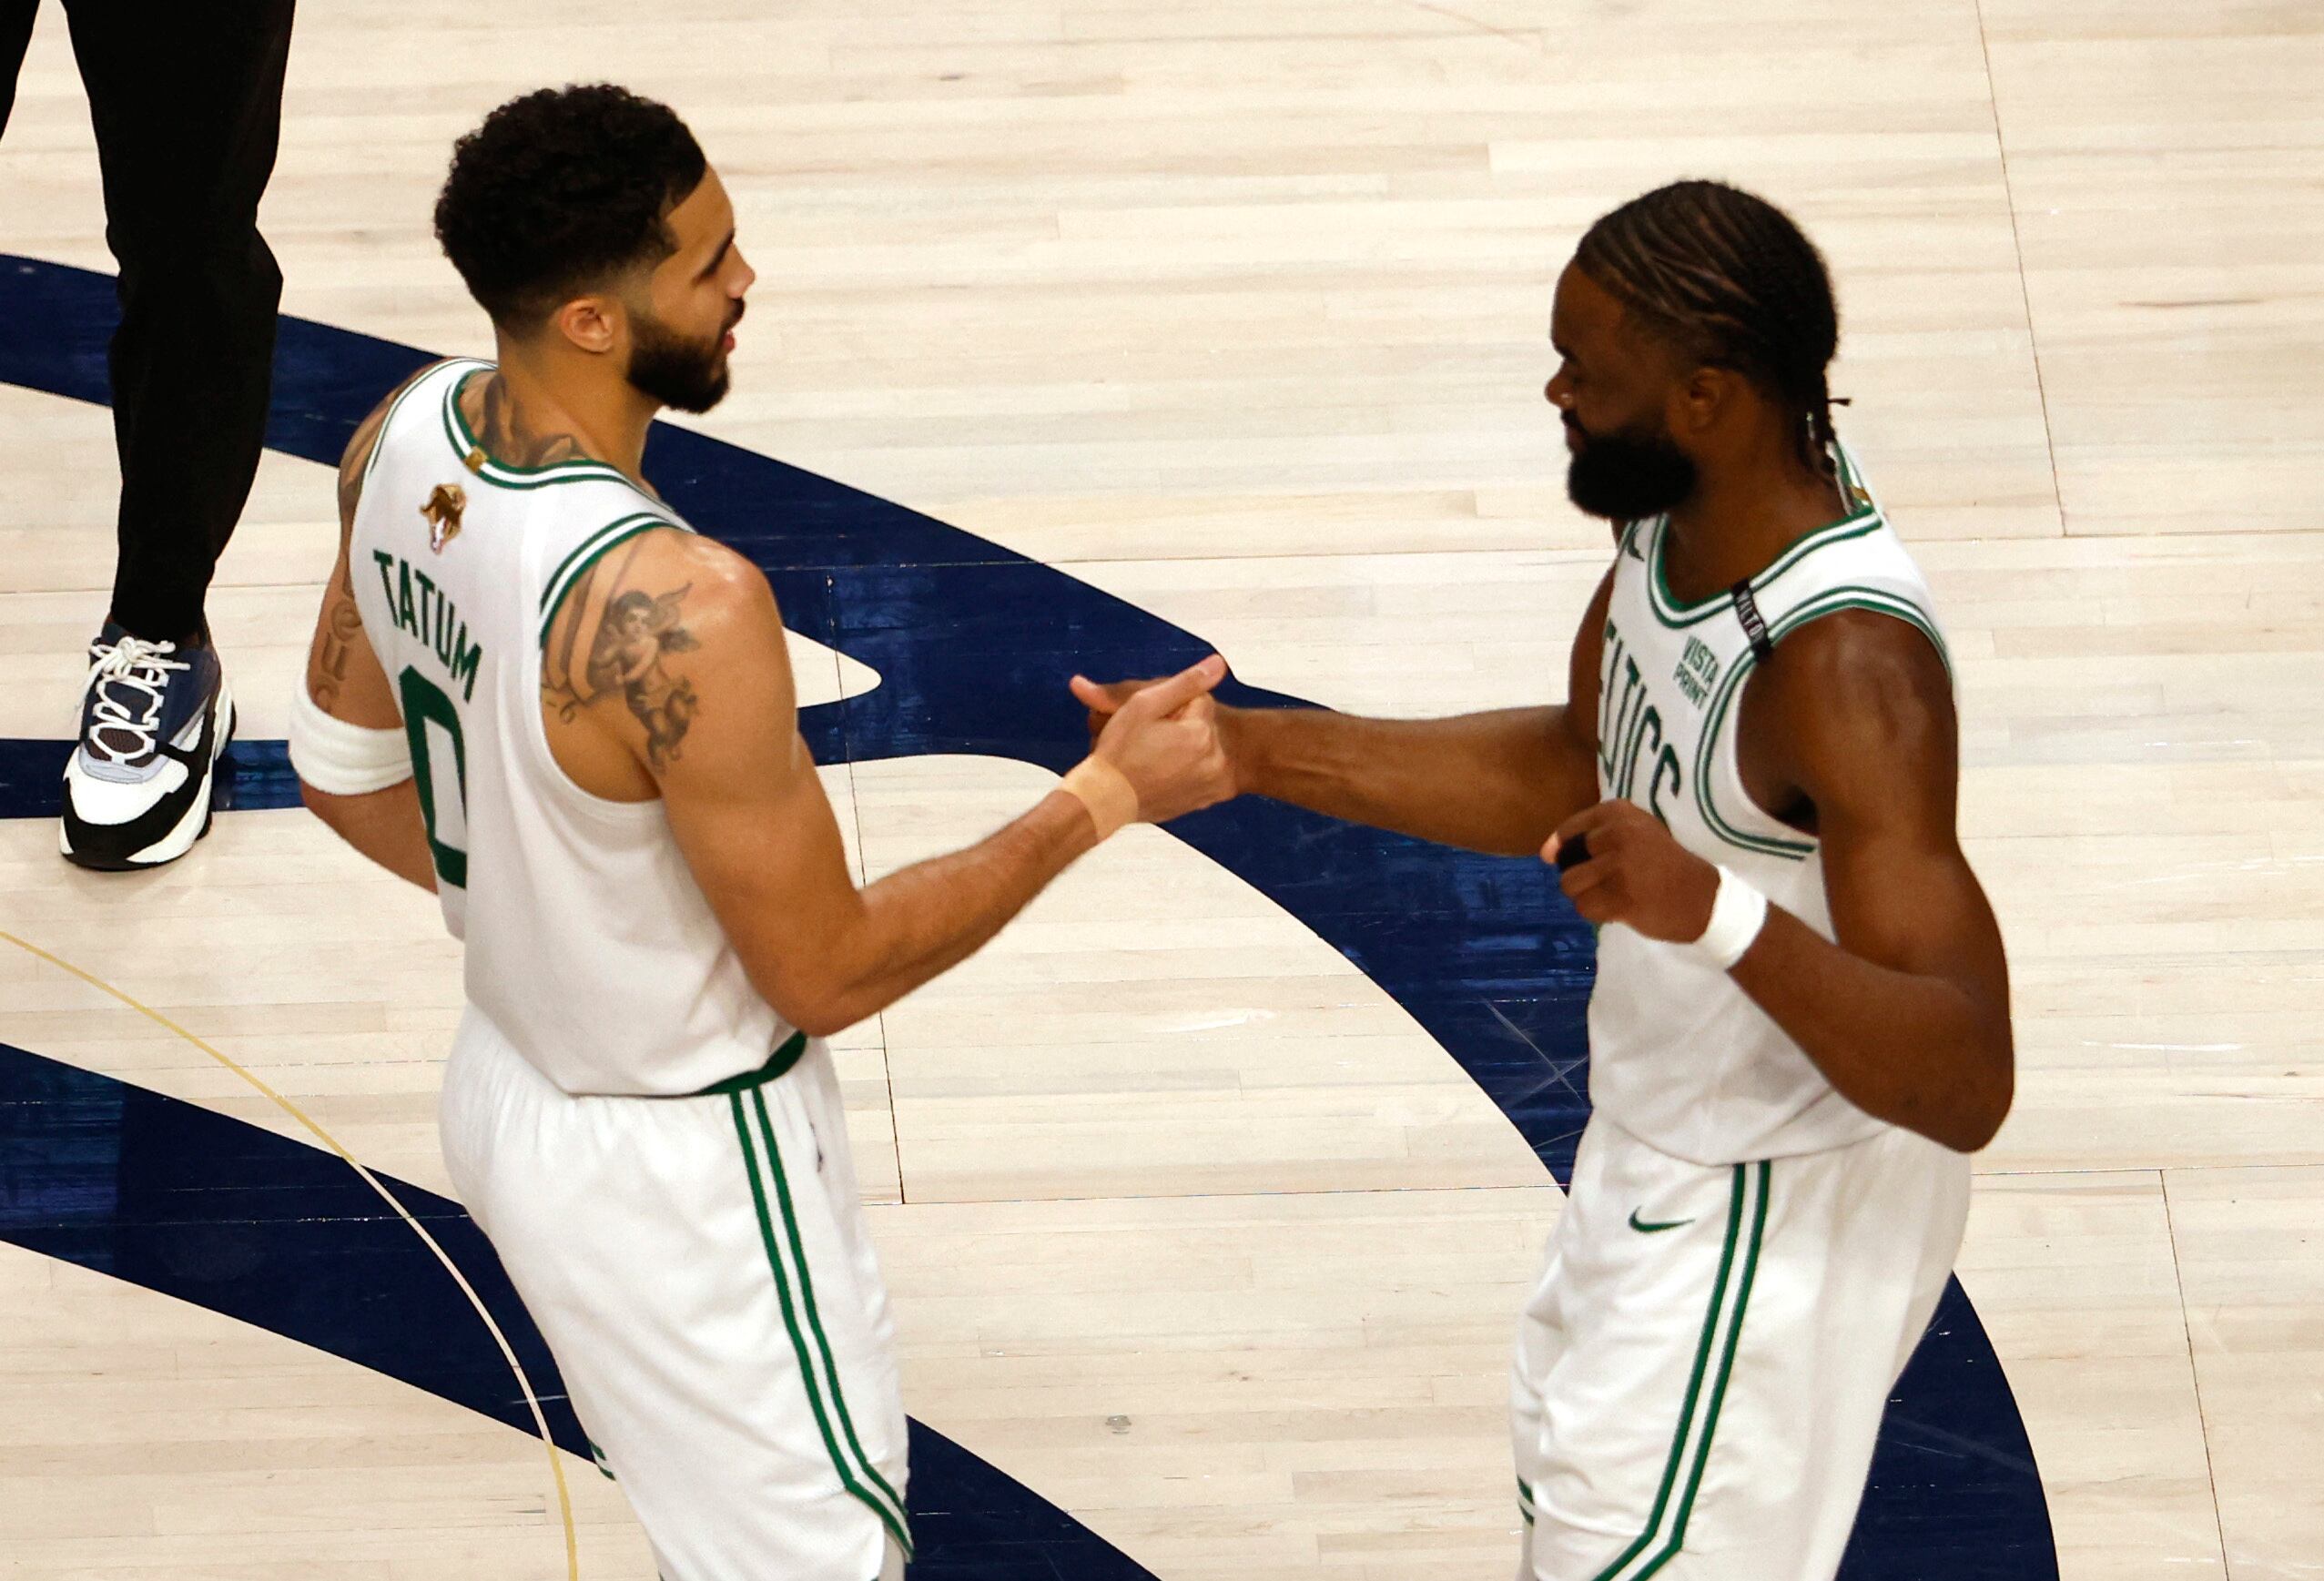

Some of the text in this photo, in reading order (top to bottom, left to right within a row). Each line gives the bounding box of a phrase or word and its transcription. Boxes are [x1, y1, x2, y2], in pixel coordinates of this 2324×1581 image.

[373, 549, 482, 704] TATUM
[1673, 661, 1709, 710] PRINT
[1682, 635, 1719, 684] VISTA
[399, 664, 468, 889] 0
[1598, 618, 1680, 837] LTICS
